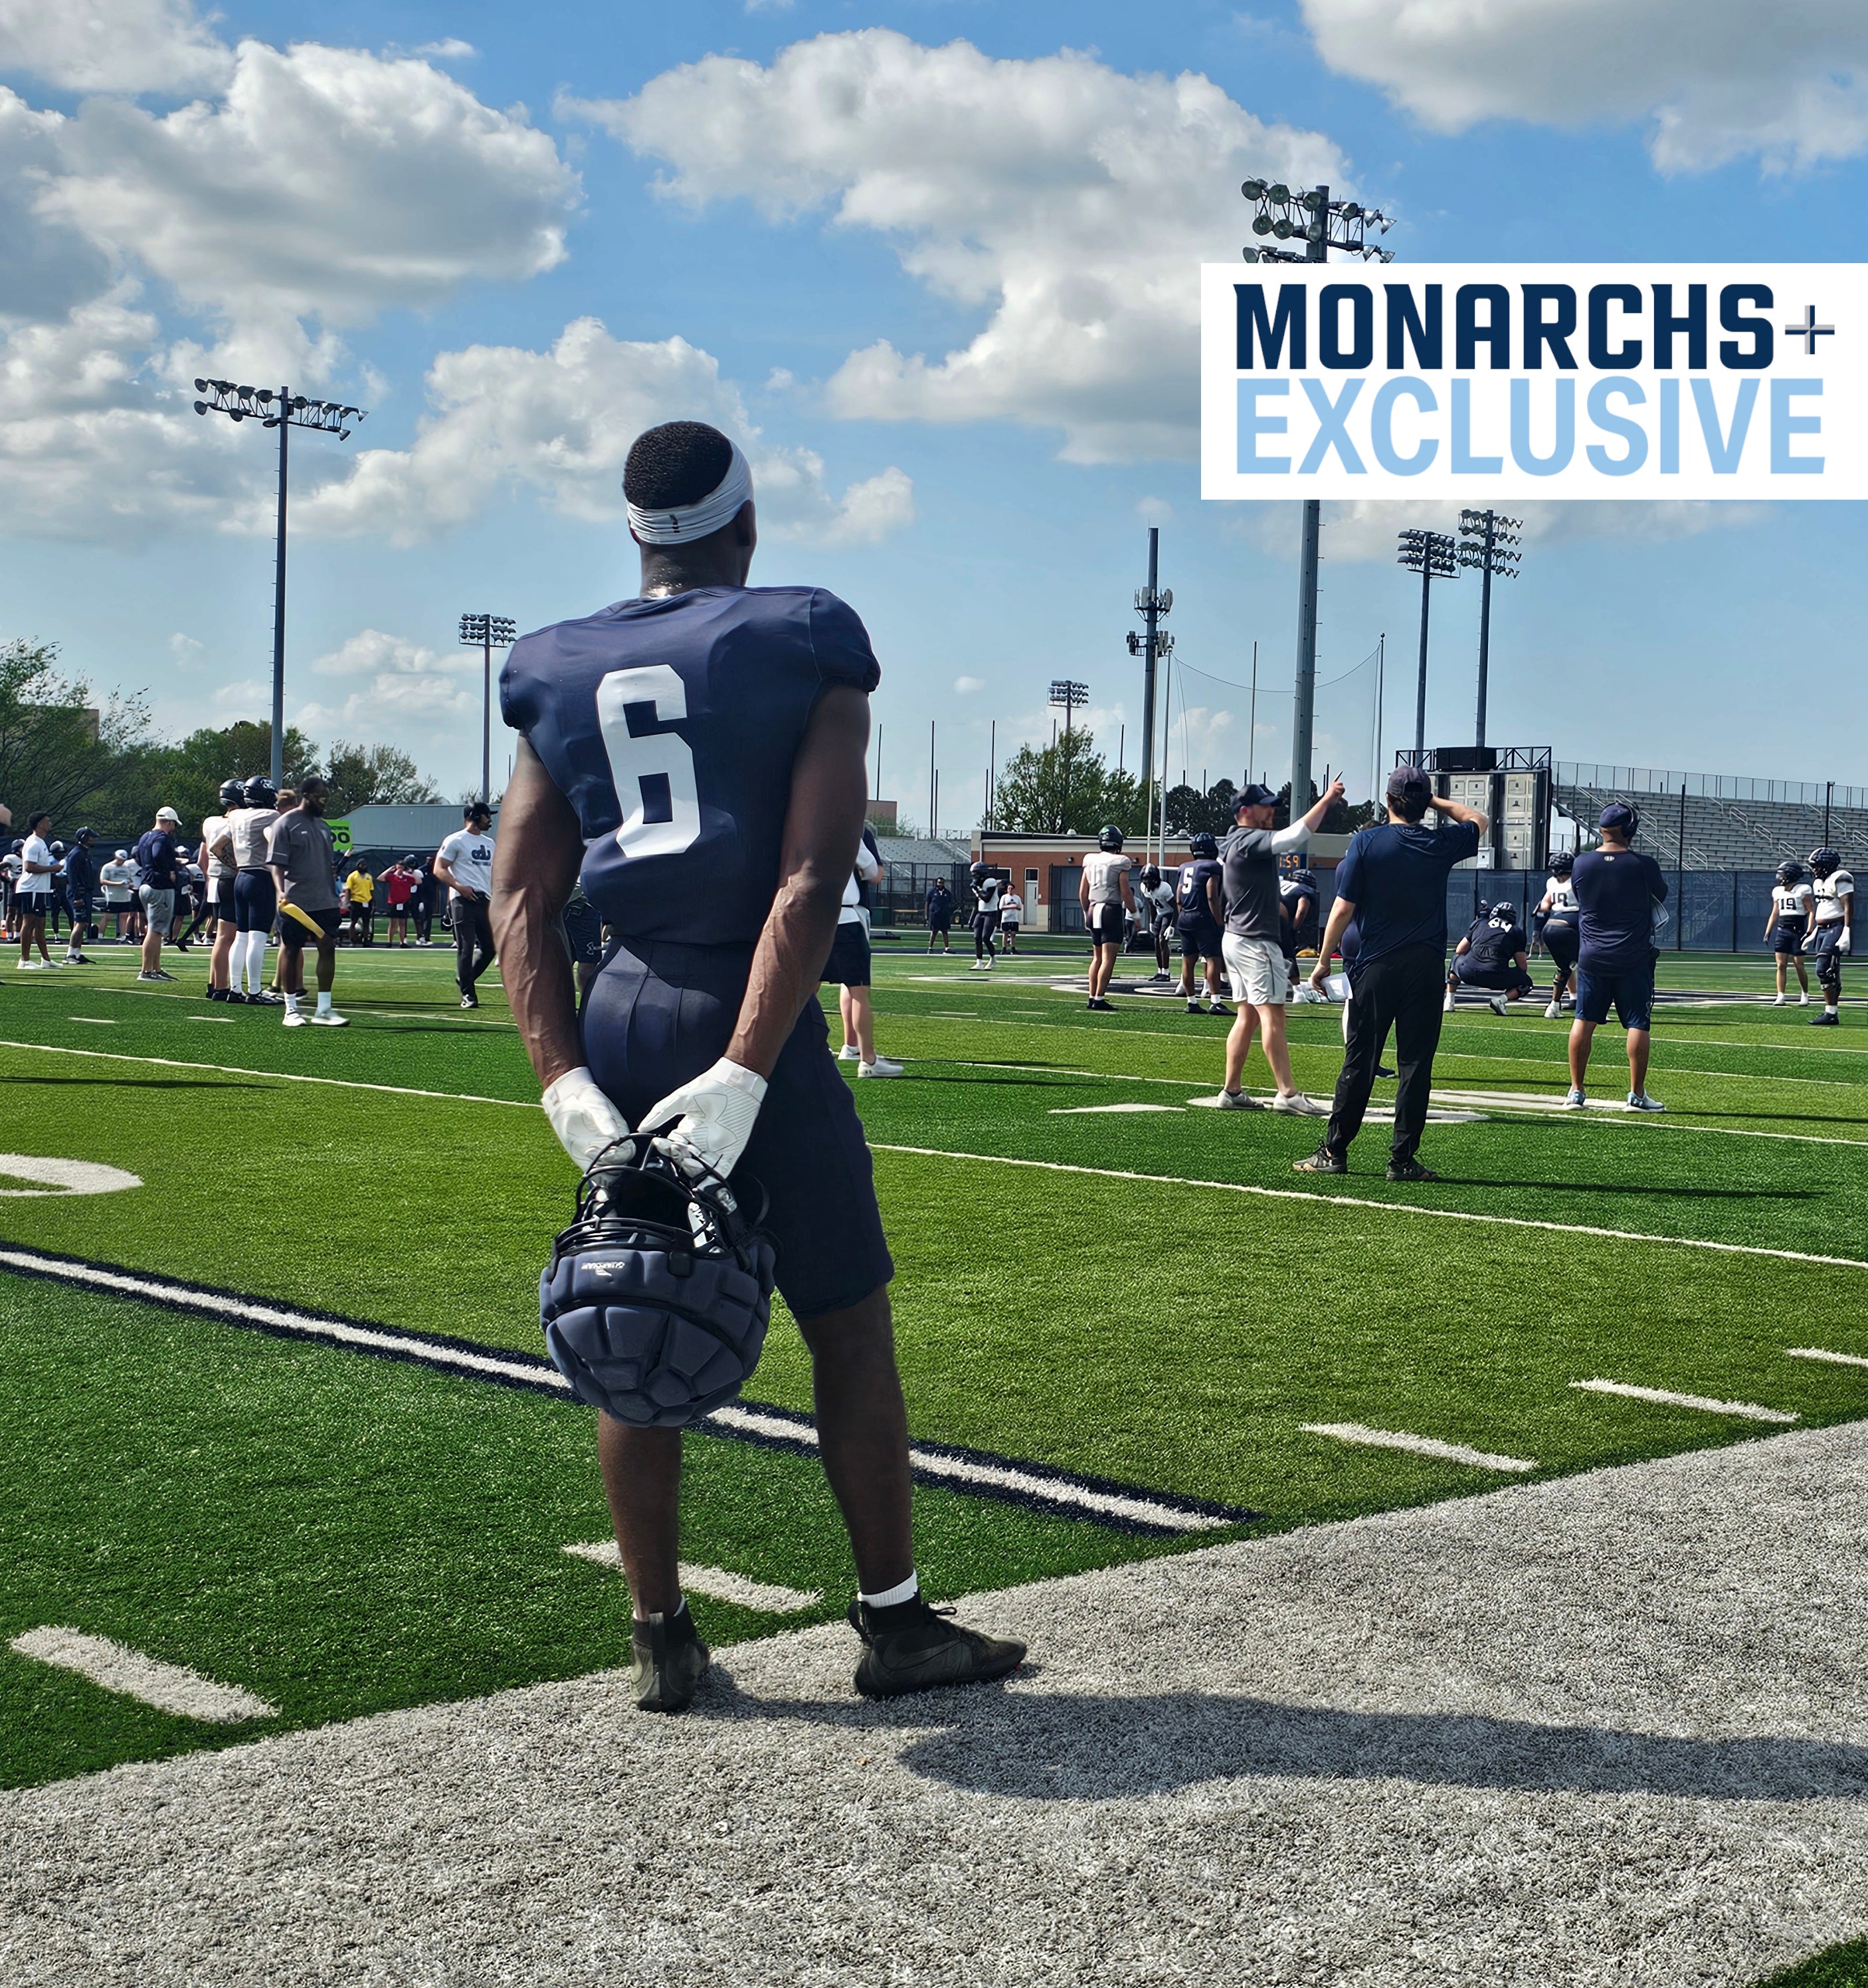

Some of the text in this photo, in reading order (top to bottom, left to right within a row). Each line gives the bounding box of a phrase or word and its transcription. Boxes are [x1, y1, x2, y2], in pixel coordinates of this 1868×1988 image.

[596, 664, 701, 858] 6
[1279, 855, 1299, 868] 1:59
[1182, 867, 1194, 894] 5
[1780, 898, 1797, 910] 19
